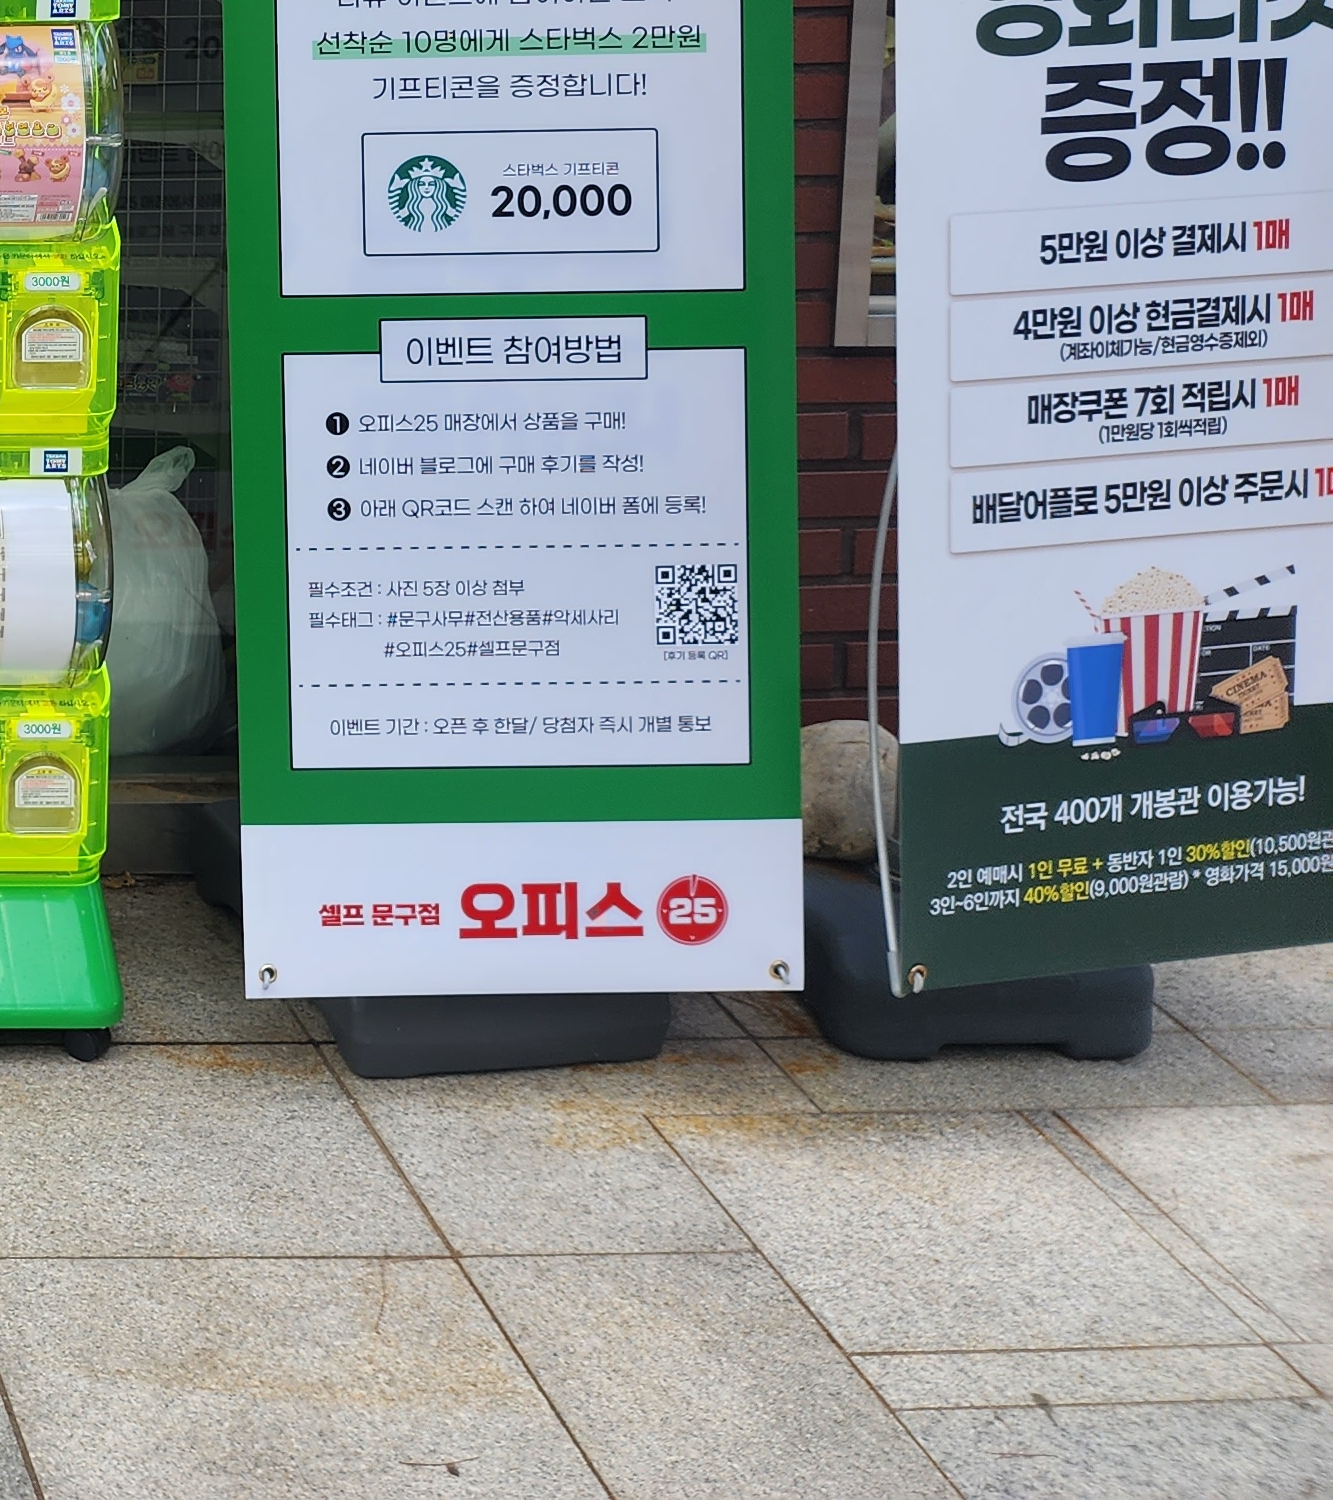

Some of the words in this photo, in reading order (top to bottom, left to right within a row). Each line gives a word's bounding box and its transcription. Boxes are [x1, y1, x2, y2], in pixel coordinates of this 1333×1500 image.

[316, 31, 393, 56] 선착순
[402, 28, 510, 54] 10명에게
[519, 26, 623, 51] 스타벅스
[632, 25, 701, 50] 2만원
[372, 75, 500, 101] 기프티콘을
[510, 73, 647, 99] 증정합니다!
[1041, 57, 1288, 183] 증정!!
[502, 163, 558, 177] 스타벅스
[563, 161, 619, 176] 기프티콘
[491, 183, 632, 220] 20,000
[1040, 230, 1108, 265] 5만원
[1115, 226, 1166, 260] 이상
[1172, 221, 1246, 256] 결제시
[1253, 218, 1290, 251] 1매
[31, 275, 70, 287] 3000원
[1013, 305, 1082, 341] 4만원
[1089, 302, 1140, 336] 이상
[1145, 292, 1271, 332] 현금결제시
[1277, 290, 1314, 323] 1매
[407, 336, 493, 366] 이벤트
[503, 334, 622, 364] 참여방법
[1027, 387, 1128, 425] 매장쿠폰
[1133, 383, 1174, 418] 7회
[1181, 378, 1256, 413] 적립시
[1263, 375, 1299, 407] 1매
[358, 413, 438, 433] 오피스25
[445, 413, 518, 432] 매장에서
[523, 413, 579, 431] 상품을
[583, 411, 625, 431] 구매!
[359, 457, 414, 476] 네이버
[420, 456, 493, 475] 블로그에
[499, 456, 535, 475] 구매
[540, 455, 596, 474] 후기를
[602, 453, 644, 472] 작성!
[360, 499, 396, 518] 아래
[402, 498, 471, 517] QR코드
[476, 498, 513, 517] 스캔
[518, 497, 556, 516] 하여
[561, 497, 616, 516] 네이버
[622, 496, 659, 515] 폼에
[664, 496, 706, 515] 등록!
[972, 485, 1098, 525] 배달어플로
[1104, 479, 1171, 514] 5만원
[1178, 474, 1229, 508] 이상
[1234, 468, 1308, 503] 주문시
[308, 581, 373, 598] 필수조건
[386, 581, 418, 597] 사진
[423, 580, 449, 597] 5장
[455, 580, 488, 596] 이상
[492, 579, 525, 596] 첨부
[308, 612, 373, 629] 필수태그
[24, 723, 61, 735] 3000원
[1000, 803, 1048, 835] 전국
[1054, 794, 1122, 826] 400개
[1130, 785, 1200, 820] 개봉관
[1208, 775, 1305, 812] 이용가능!
[1205, 862, 1264, 886] 영화가격
[319, 903, 364, 927] 셀프
[372, 903, 440, 926] 문구점
[459, 881, 644, 940] 오피스
[668, 897, 717, 924] 25
